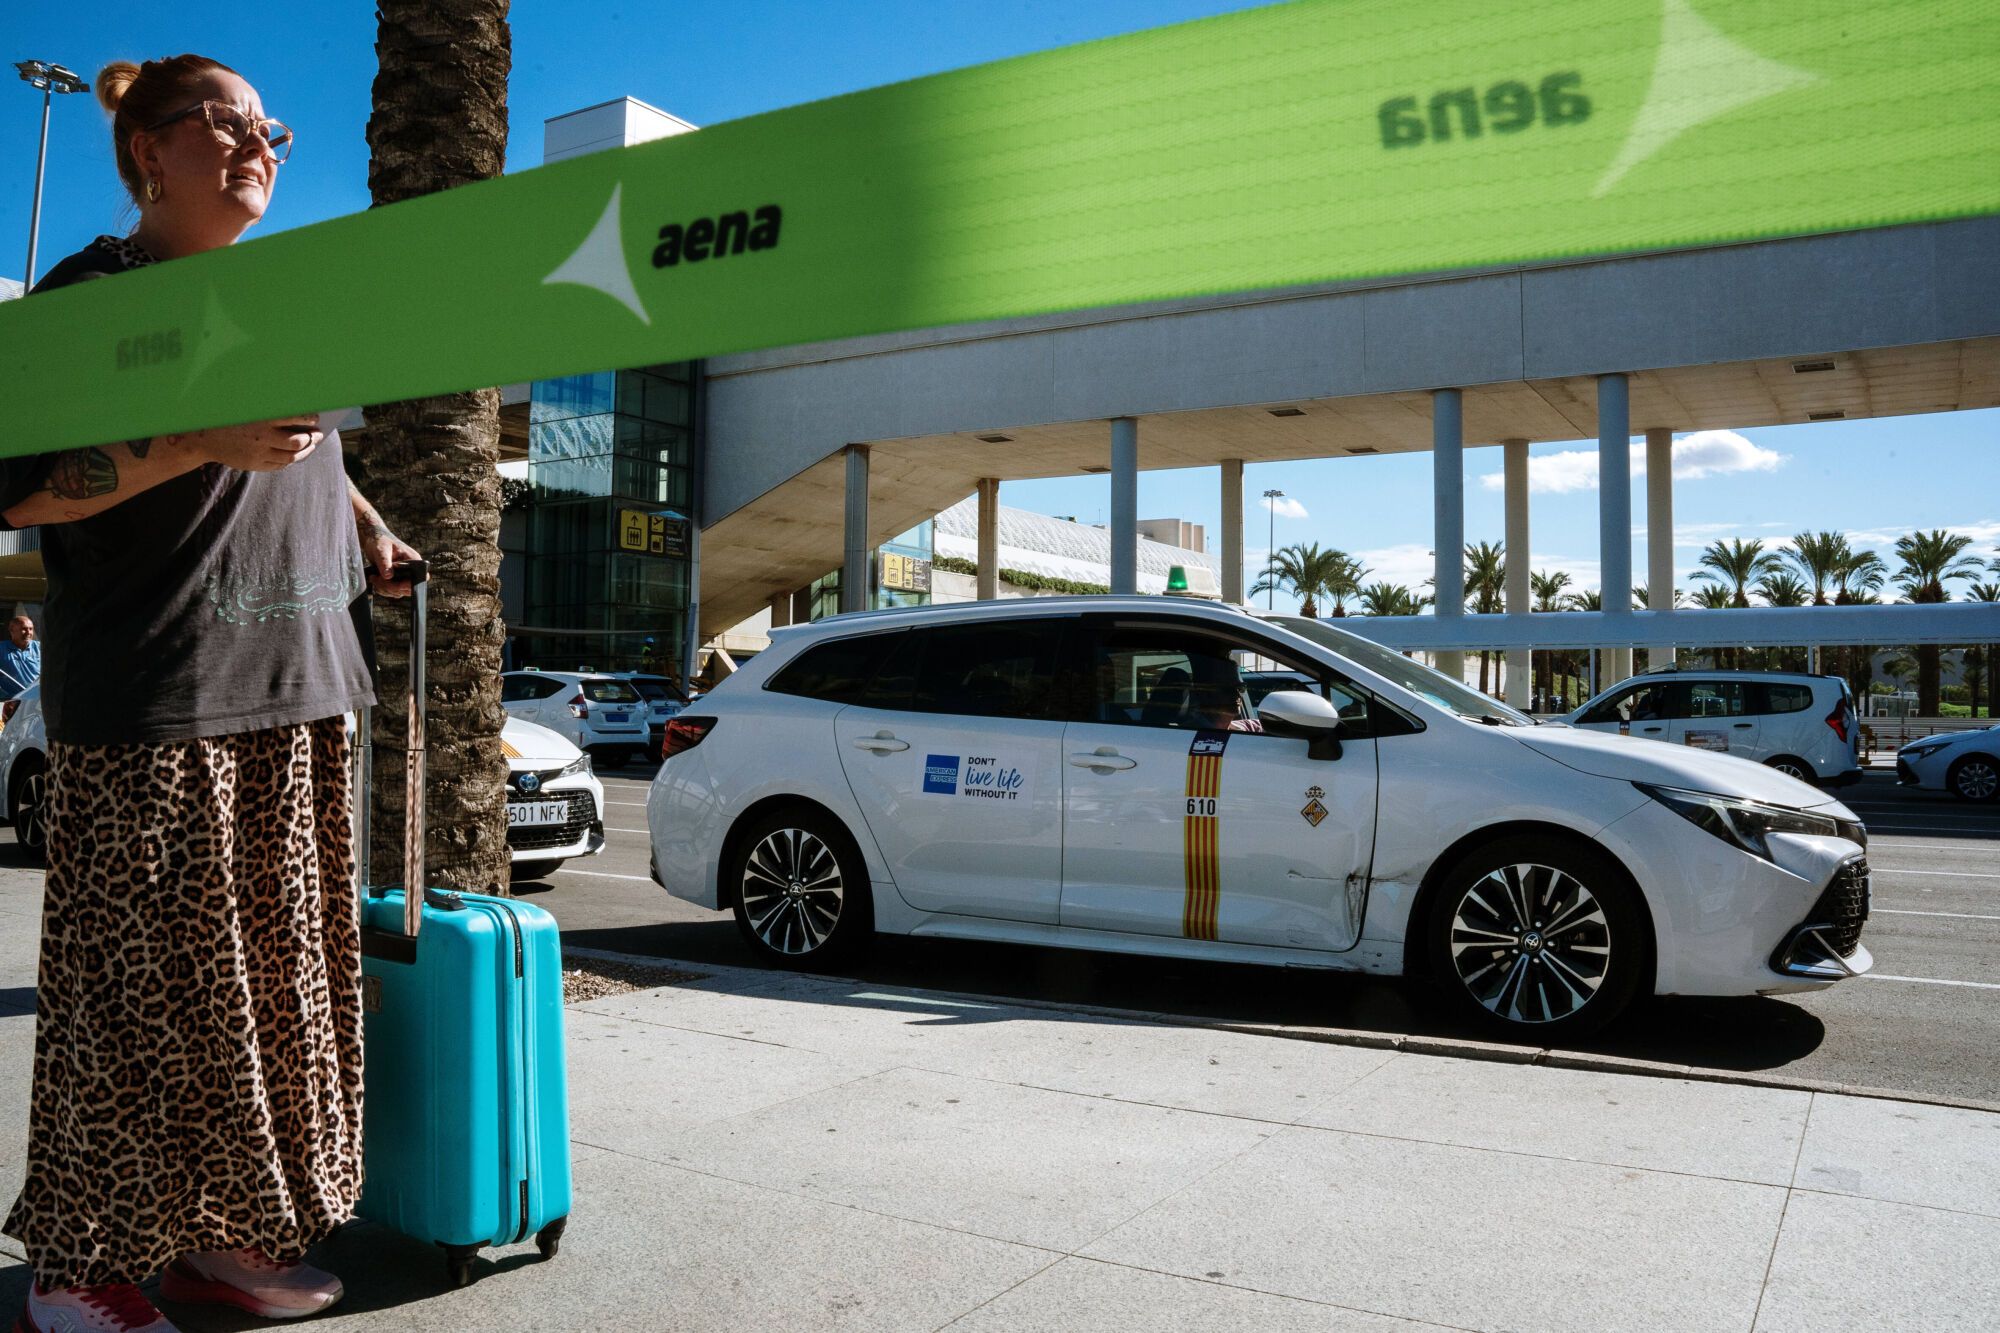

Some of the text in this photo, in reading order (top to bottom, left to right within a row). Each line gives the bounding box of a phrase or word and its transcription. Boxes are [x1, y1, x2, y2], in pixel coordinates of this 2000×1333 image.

[651, 204, 782, 270] aena
[968, 757, 996, 766] DON'T
[925, 766, 957, 775] AMERICAN
[929, 775, 957, 784] EXPRESS
[965, 766, 1024, 791] live life
[964, 788, 1018, 800] WITHOUT IT
[540, 804, 565, 822] NFK
[1186, 799, 1216, 815] 610
